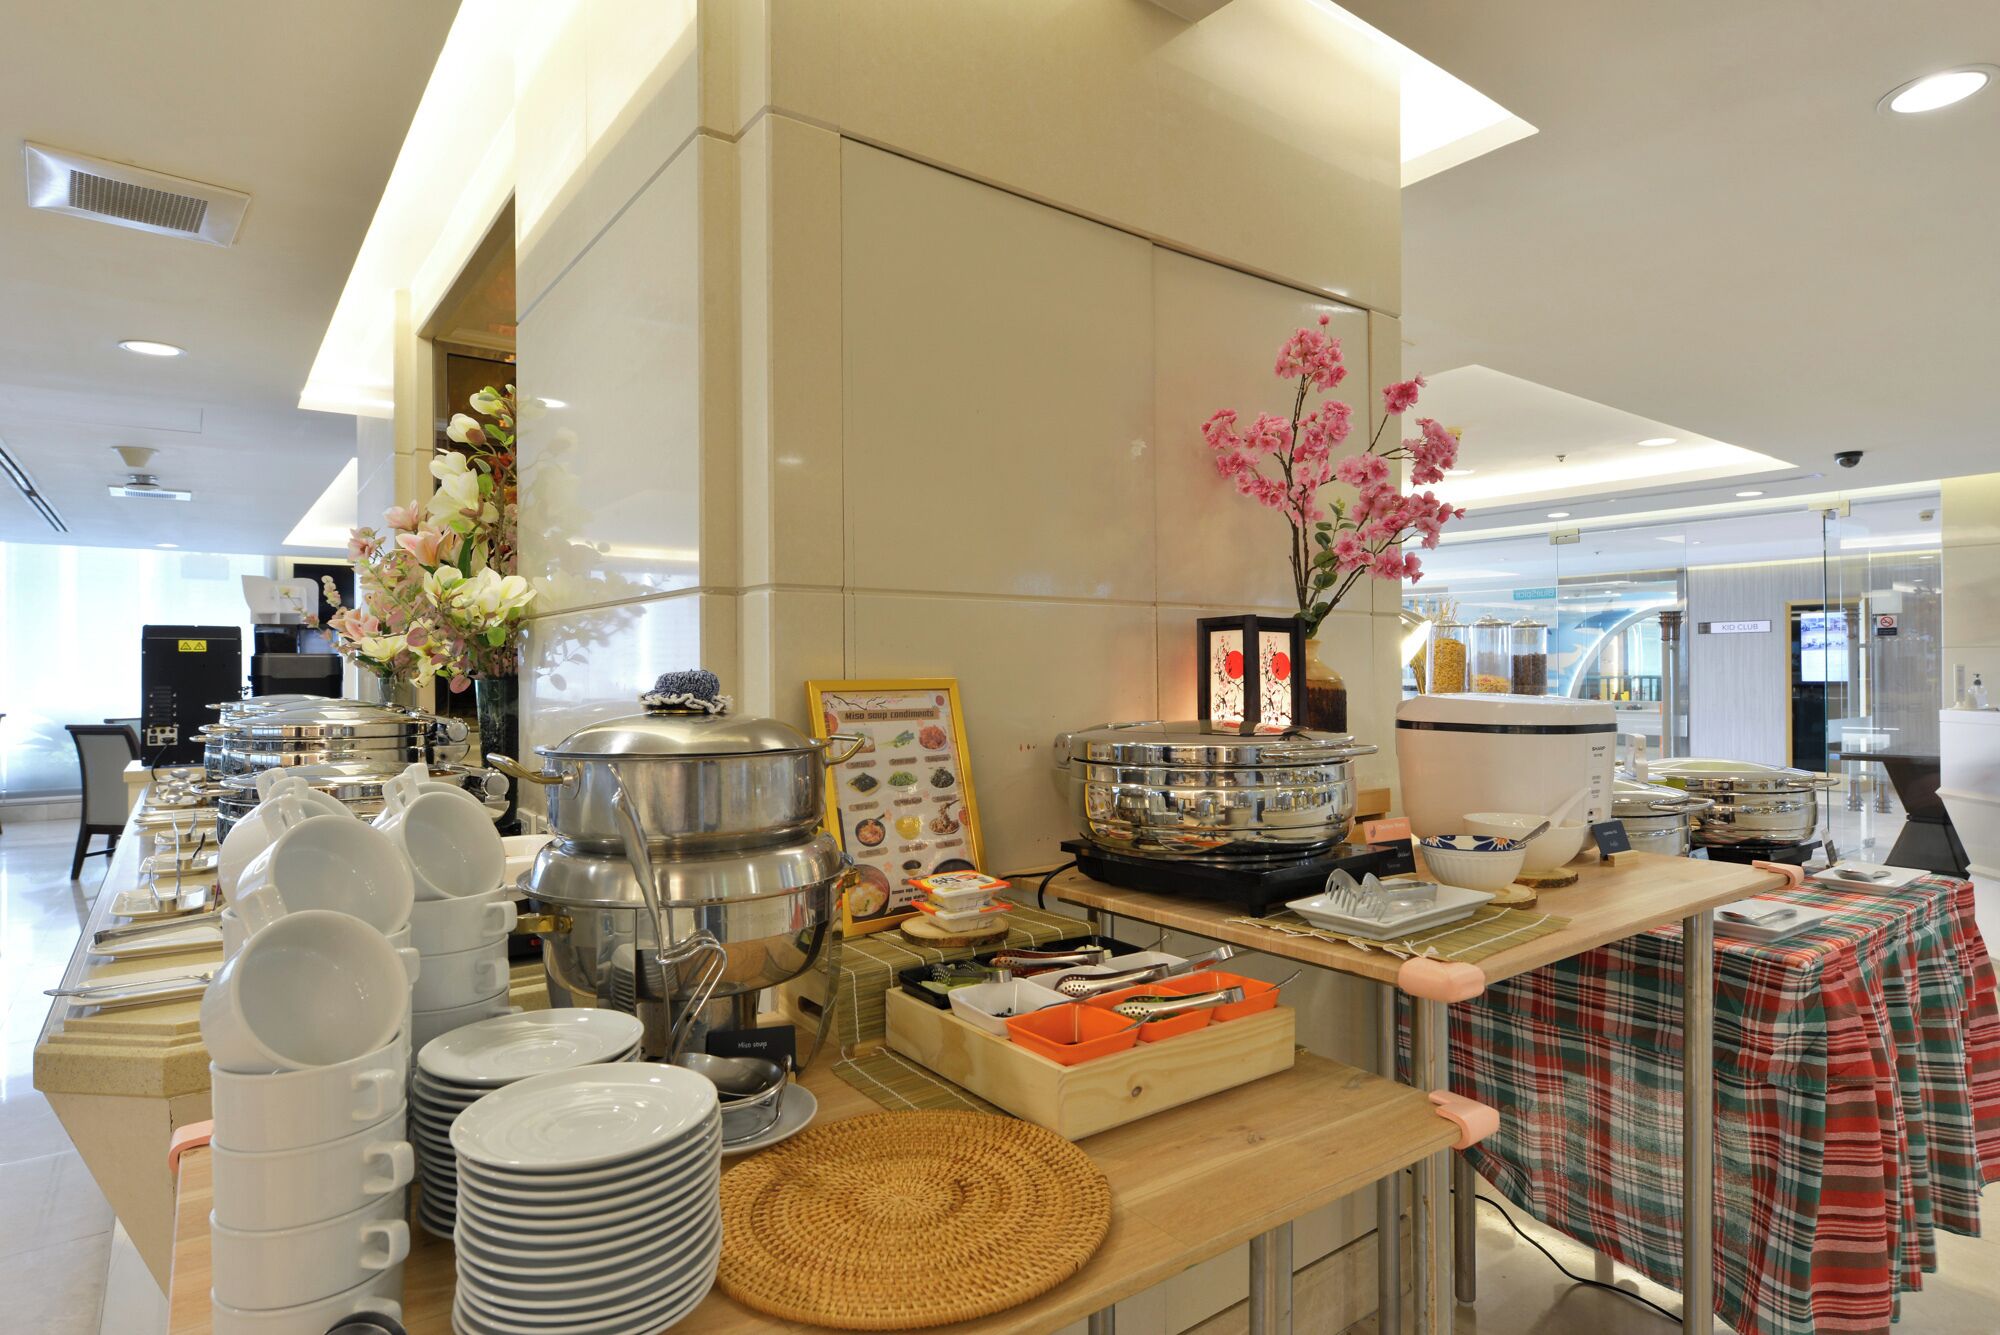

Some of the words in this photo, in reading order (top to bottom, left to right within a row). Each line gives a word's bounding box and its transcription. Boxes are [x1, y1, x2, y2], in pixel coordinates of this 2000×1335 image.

[844, 711, 865, 720] Miso
[867, 711, 888, 720] soup
[890, 709, 934, 719] condiments
[737, 1041, 752, 1049] Miso
